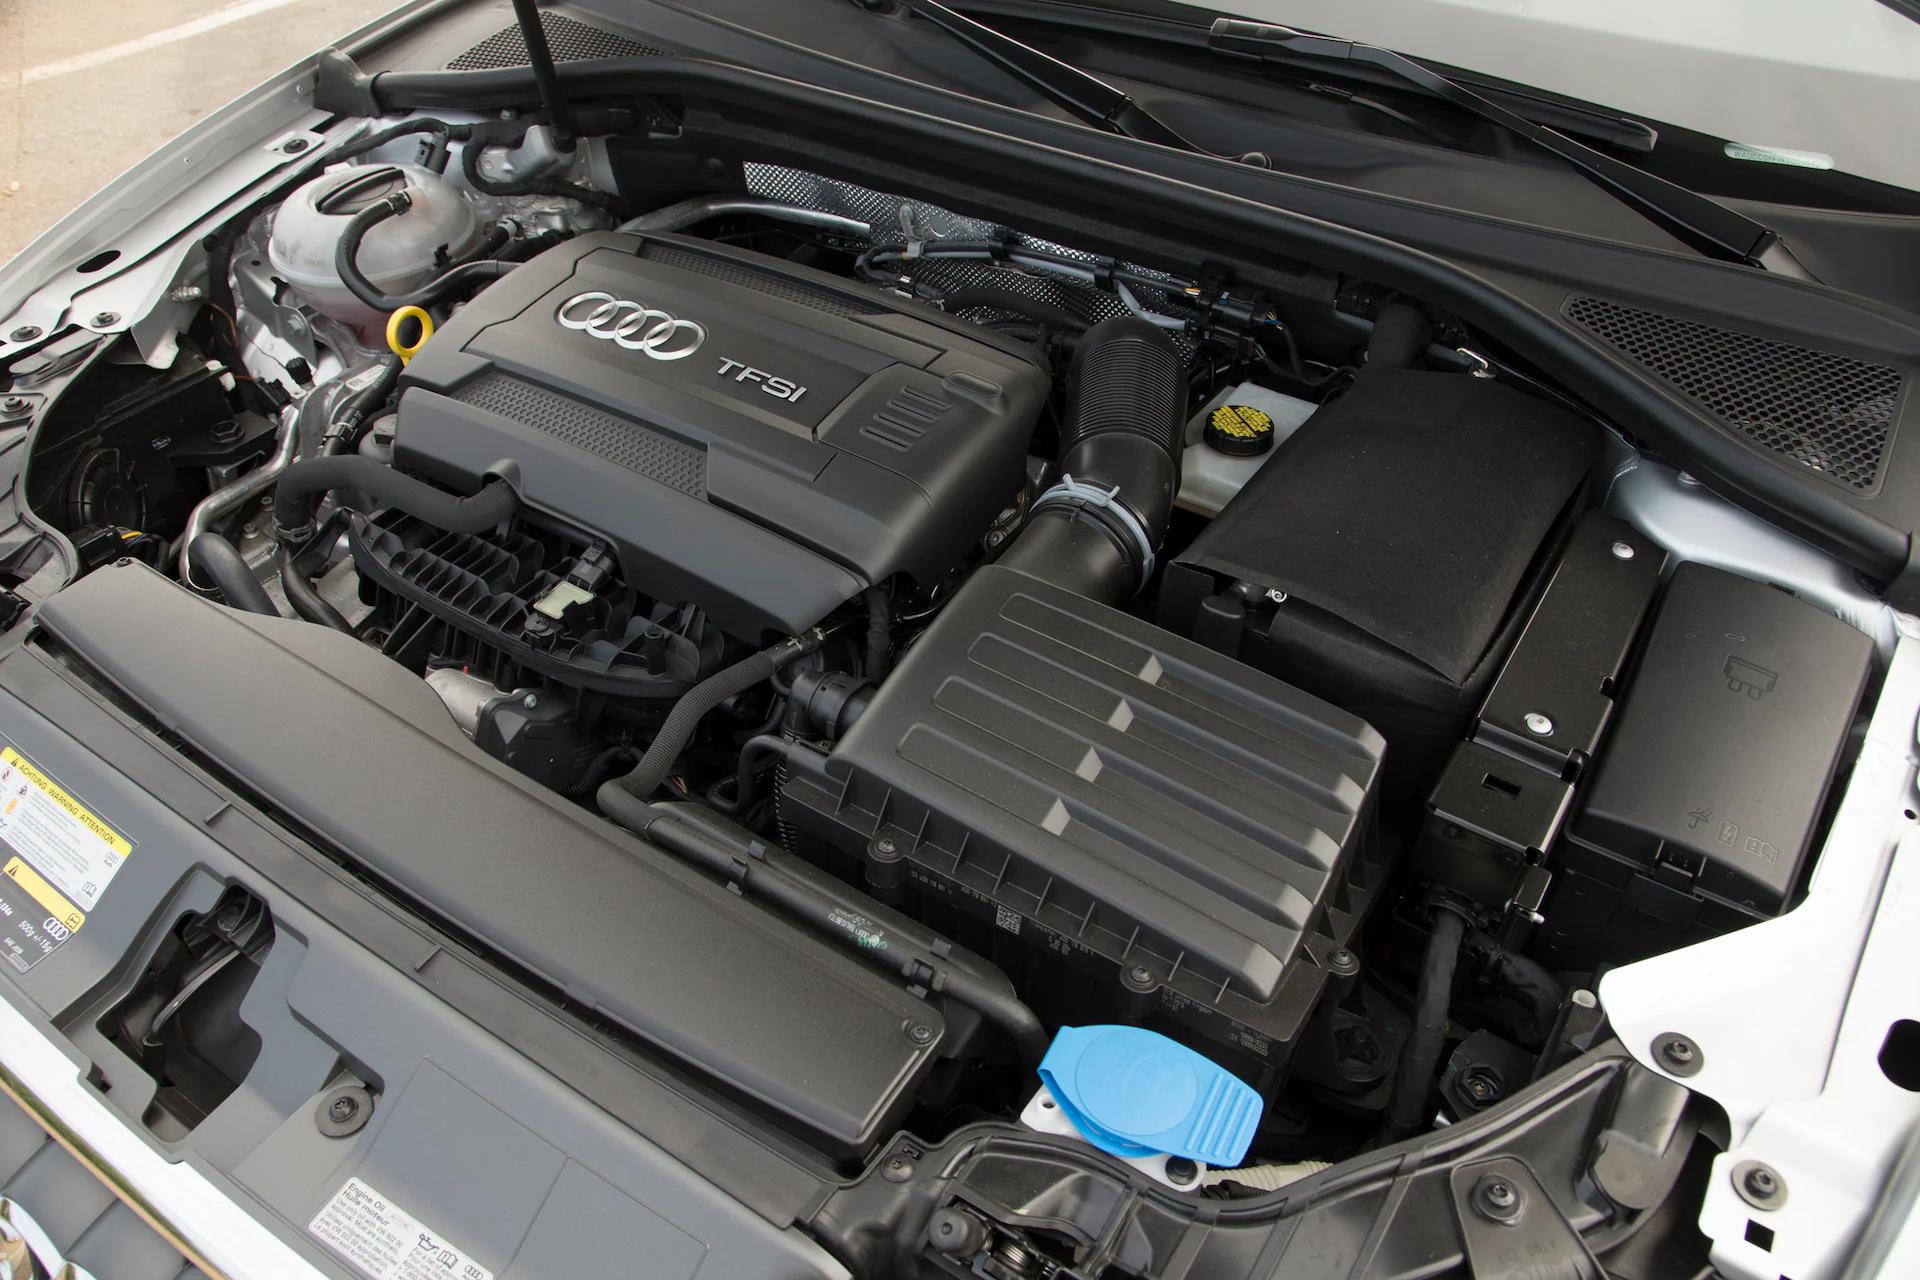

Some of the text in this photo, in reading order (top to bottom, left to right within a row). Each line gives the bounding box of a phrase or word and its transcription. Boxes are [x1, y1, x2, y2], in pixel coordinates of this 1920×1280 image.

[718, 356, 808, 403] TFSI
[19, 764, 48, 790] ACHTUNG
[48, 788, 79, 816] WARNING
[79, 814, 116, 845] ATTENTION
[342, 1190, 362, 1205] Huile
[360, 1205, 389, 1226] moteur
[347, 1183, 386, 1211] Engine Oil
